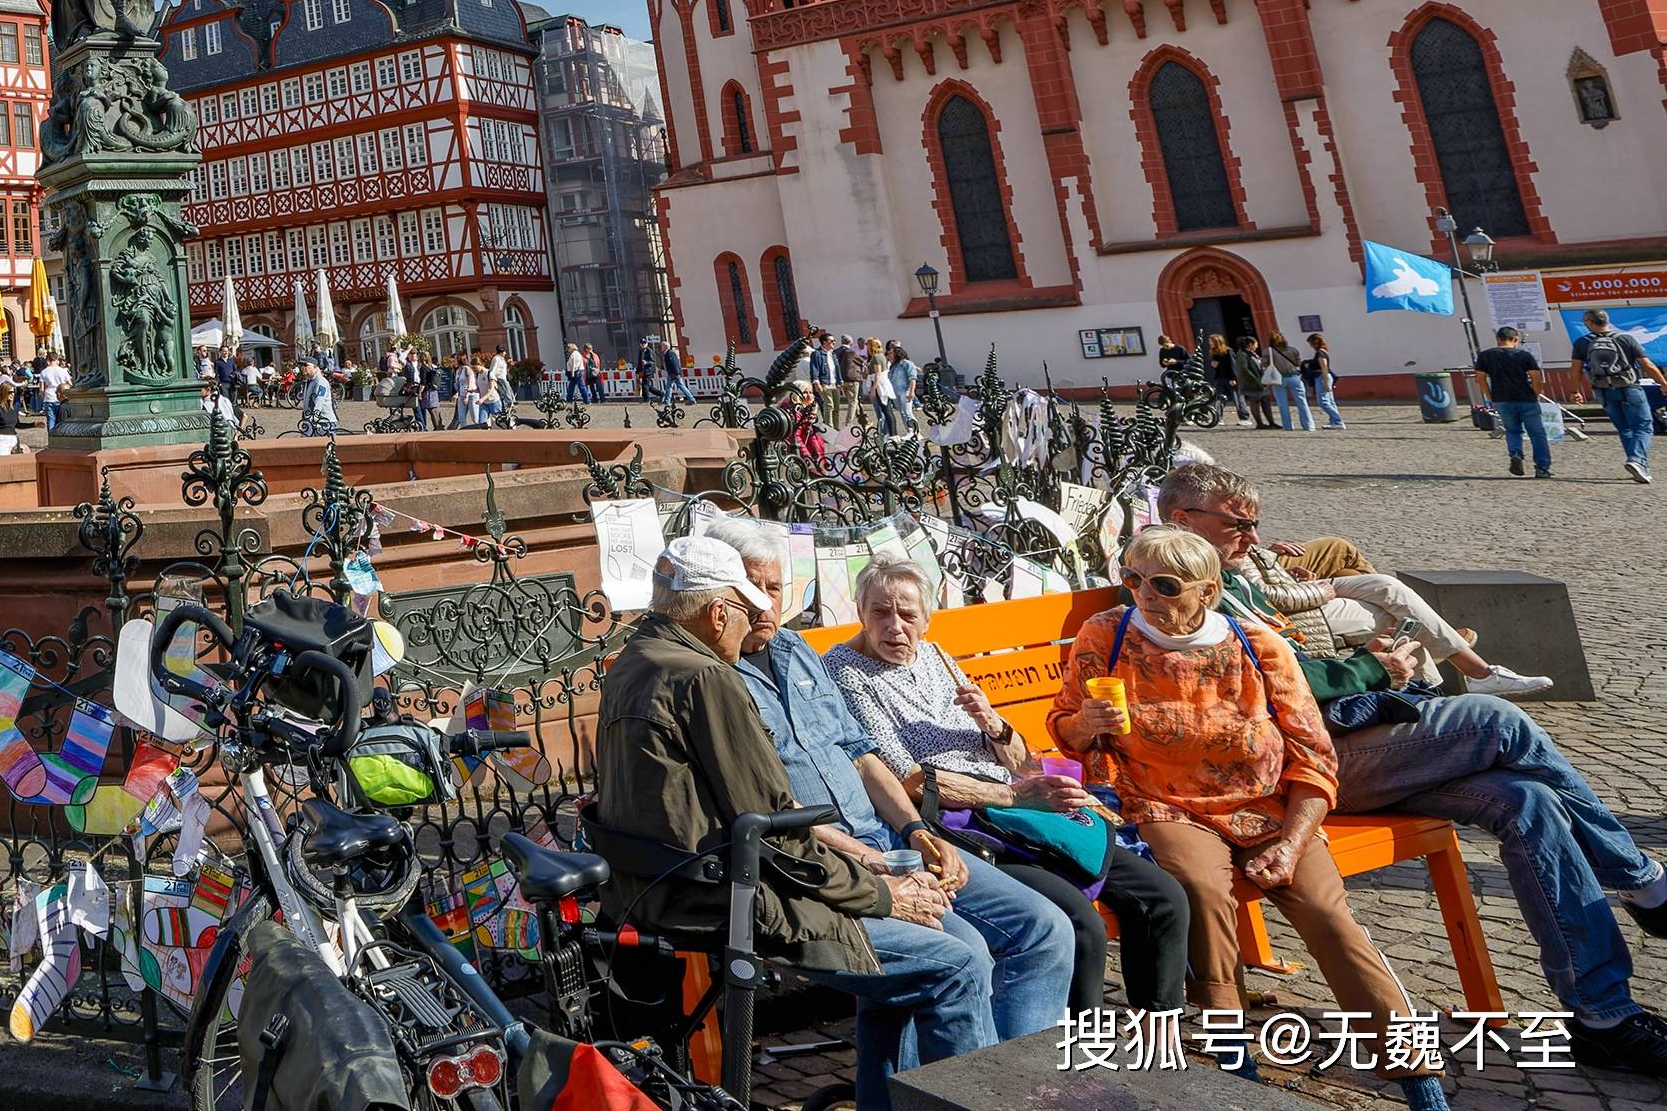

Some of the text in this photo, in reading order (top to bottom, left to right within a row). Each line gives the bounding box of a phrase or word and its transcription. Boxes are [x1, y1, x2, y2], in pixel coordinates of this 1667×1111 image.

[1578, 277, 1661, 290] 1.000.000
[237, 296, 287, 311] STAURANT
[922, 514, 931, 524] 21
[611, 544, 633, 553] LOS?
[13, 660, 24, 672] 21
[1045, 661, 1067, 681] un
[77, 698, 89, 711] 21
[164, 880, 176, 892] 21
